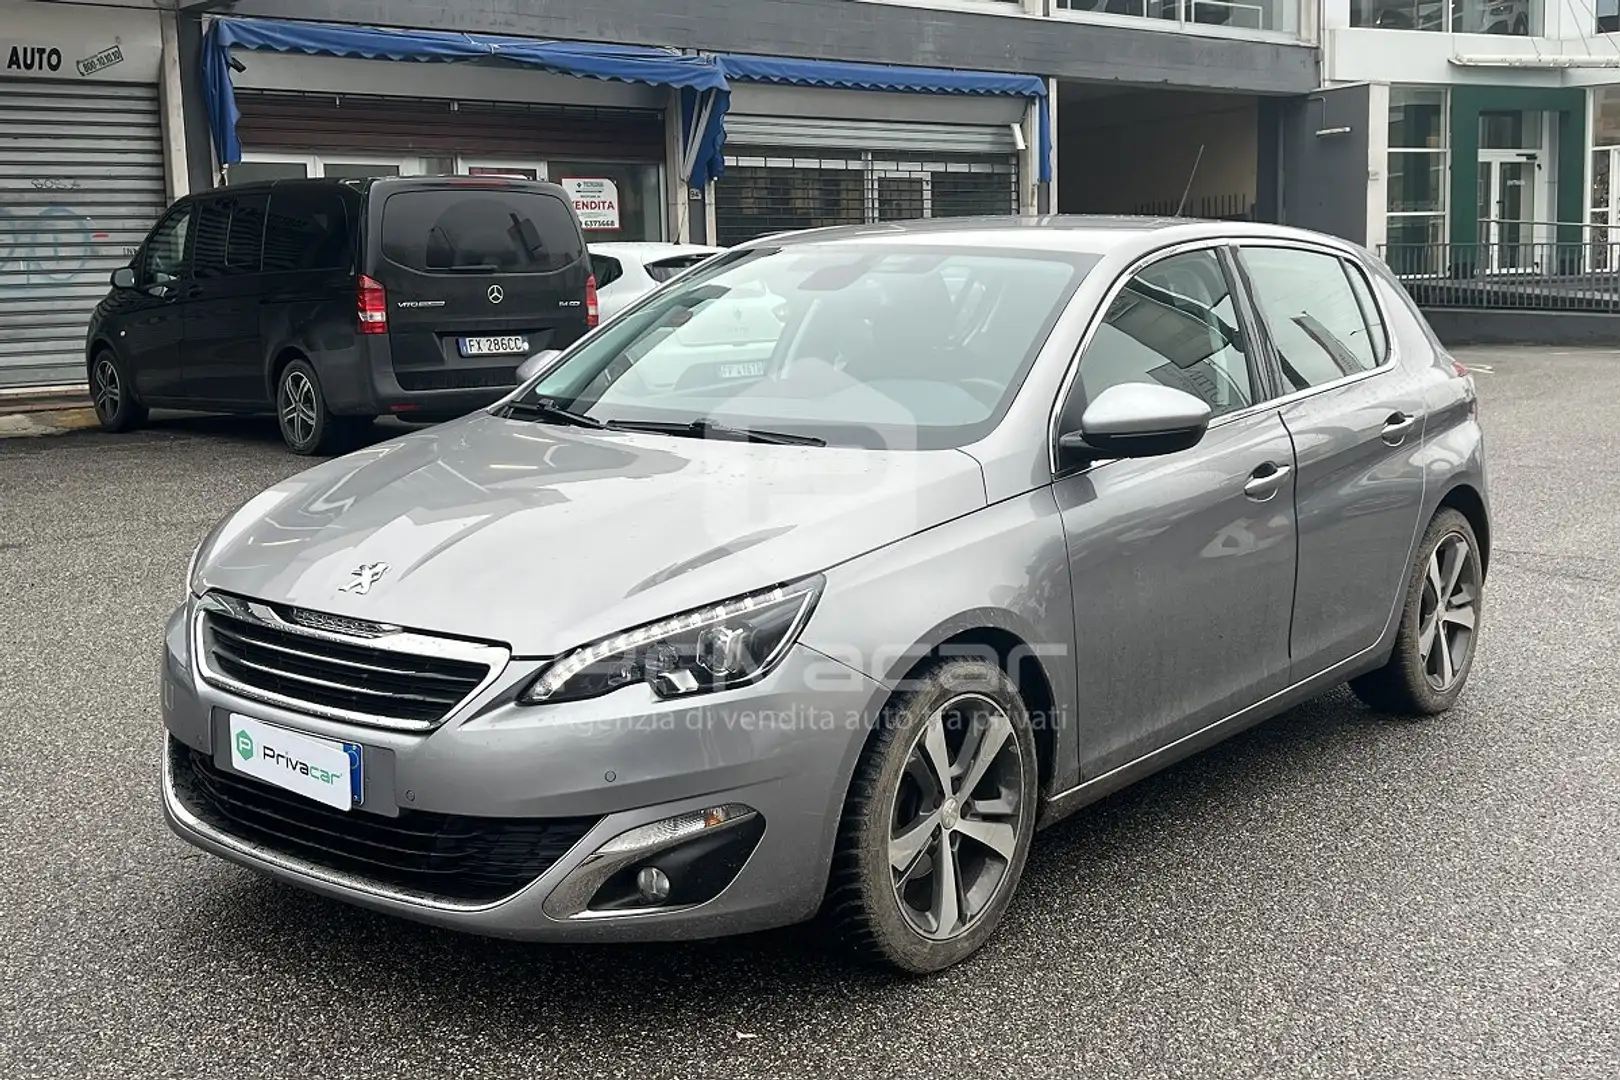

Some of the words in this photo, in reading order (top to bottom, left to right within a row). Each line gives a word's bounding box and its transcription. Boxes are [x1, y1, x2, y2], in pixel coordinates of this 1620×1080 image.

[7, 46, 62, 72] AUTO
[573, 200, 615, 211] ENDITA
[468, 339, 483, 353] FX
[486, 337, 521, 352] 286CC
[263, 745, 341, 785] Privacar
